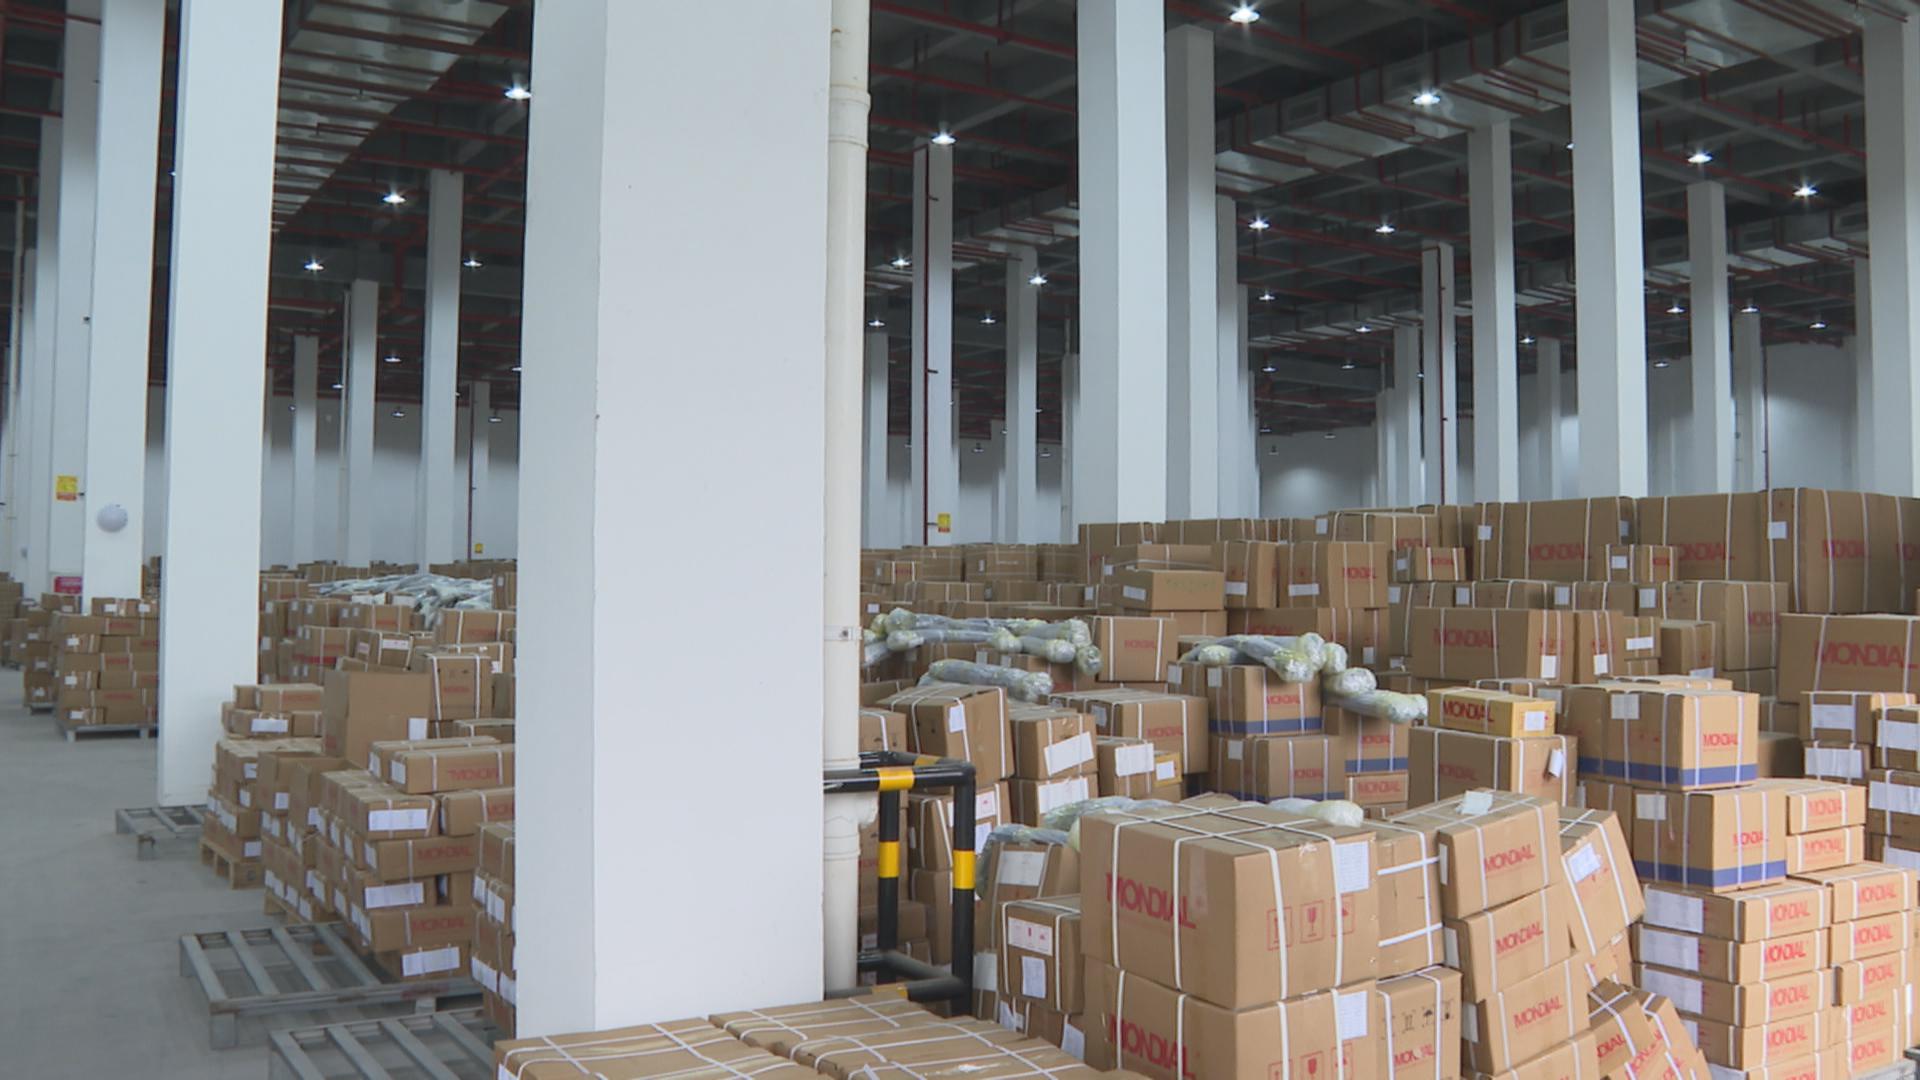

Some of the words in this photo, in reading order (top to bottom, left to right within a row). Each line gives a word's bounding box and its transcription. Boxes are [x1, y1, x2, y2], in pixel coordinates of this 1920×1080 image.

[1814, 642, 1918, 669] MONDIAL
[1484, 844, 1535, 873] MONDIAL
[1106, 872, 1196, 929] MONDIAL
[1495, 921, 1544, 955] MONDIAL
[1513, 994, 1565, 1030] MONDIAL
[1109, 1014, 1196, 1080] MONDIAL
